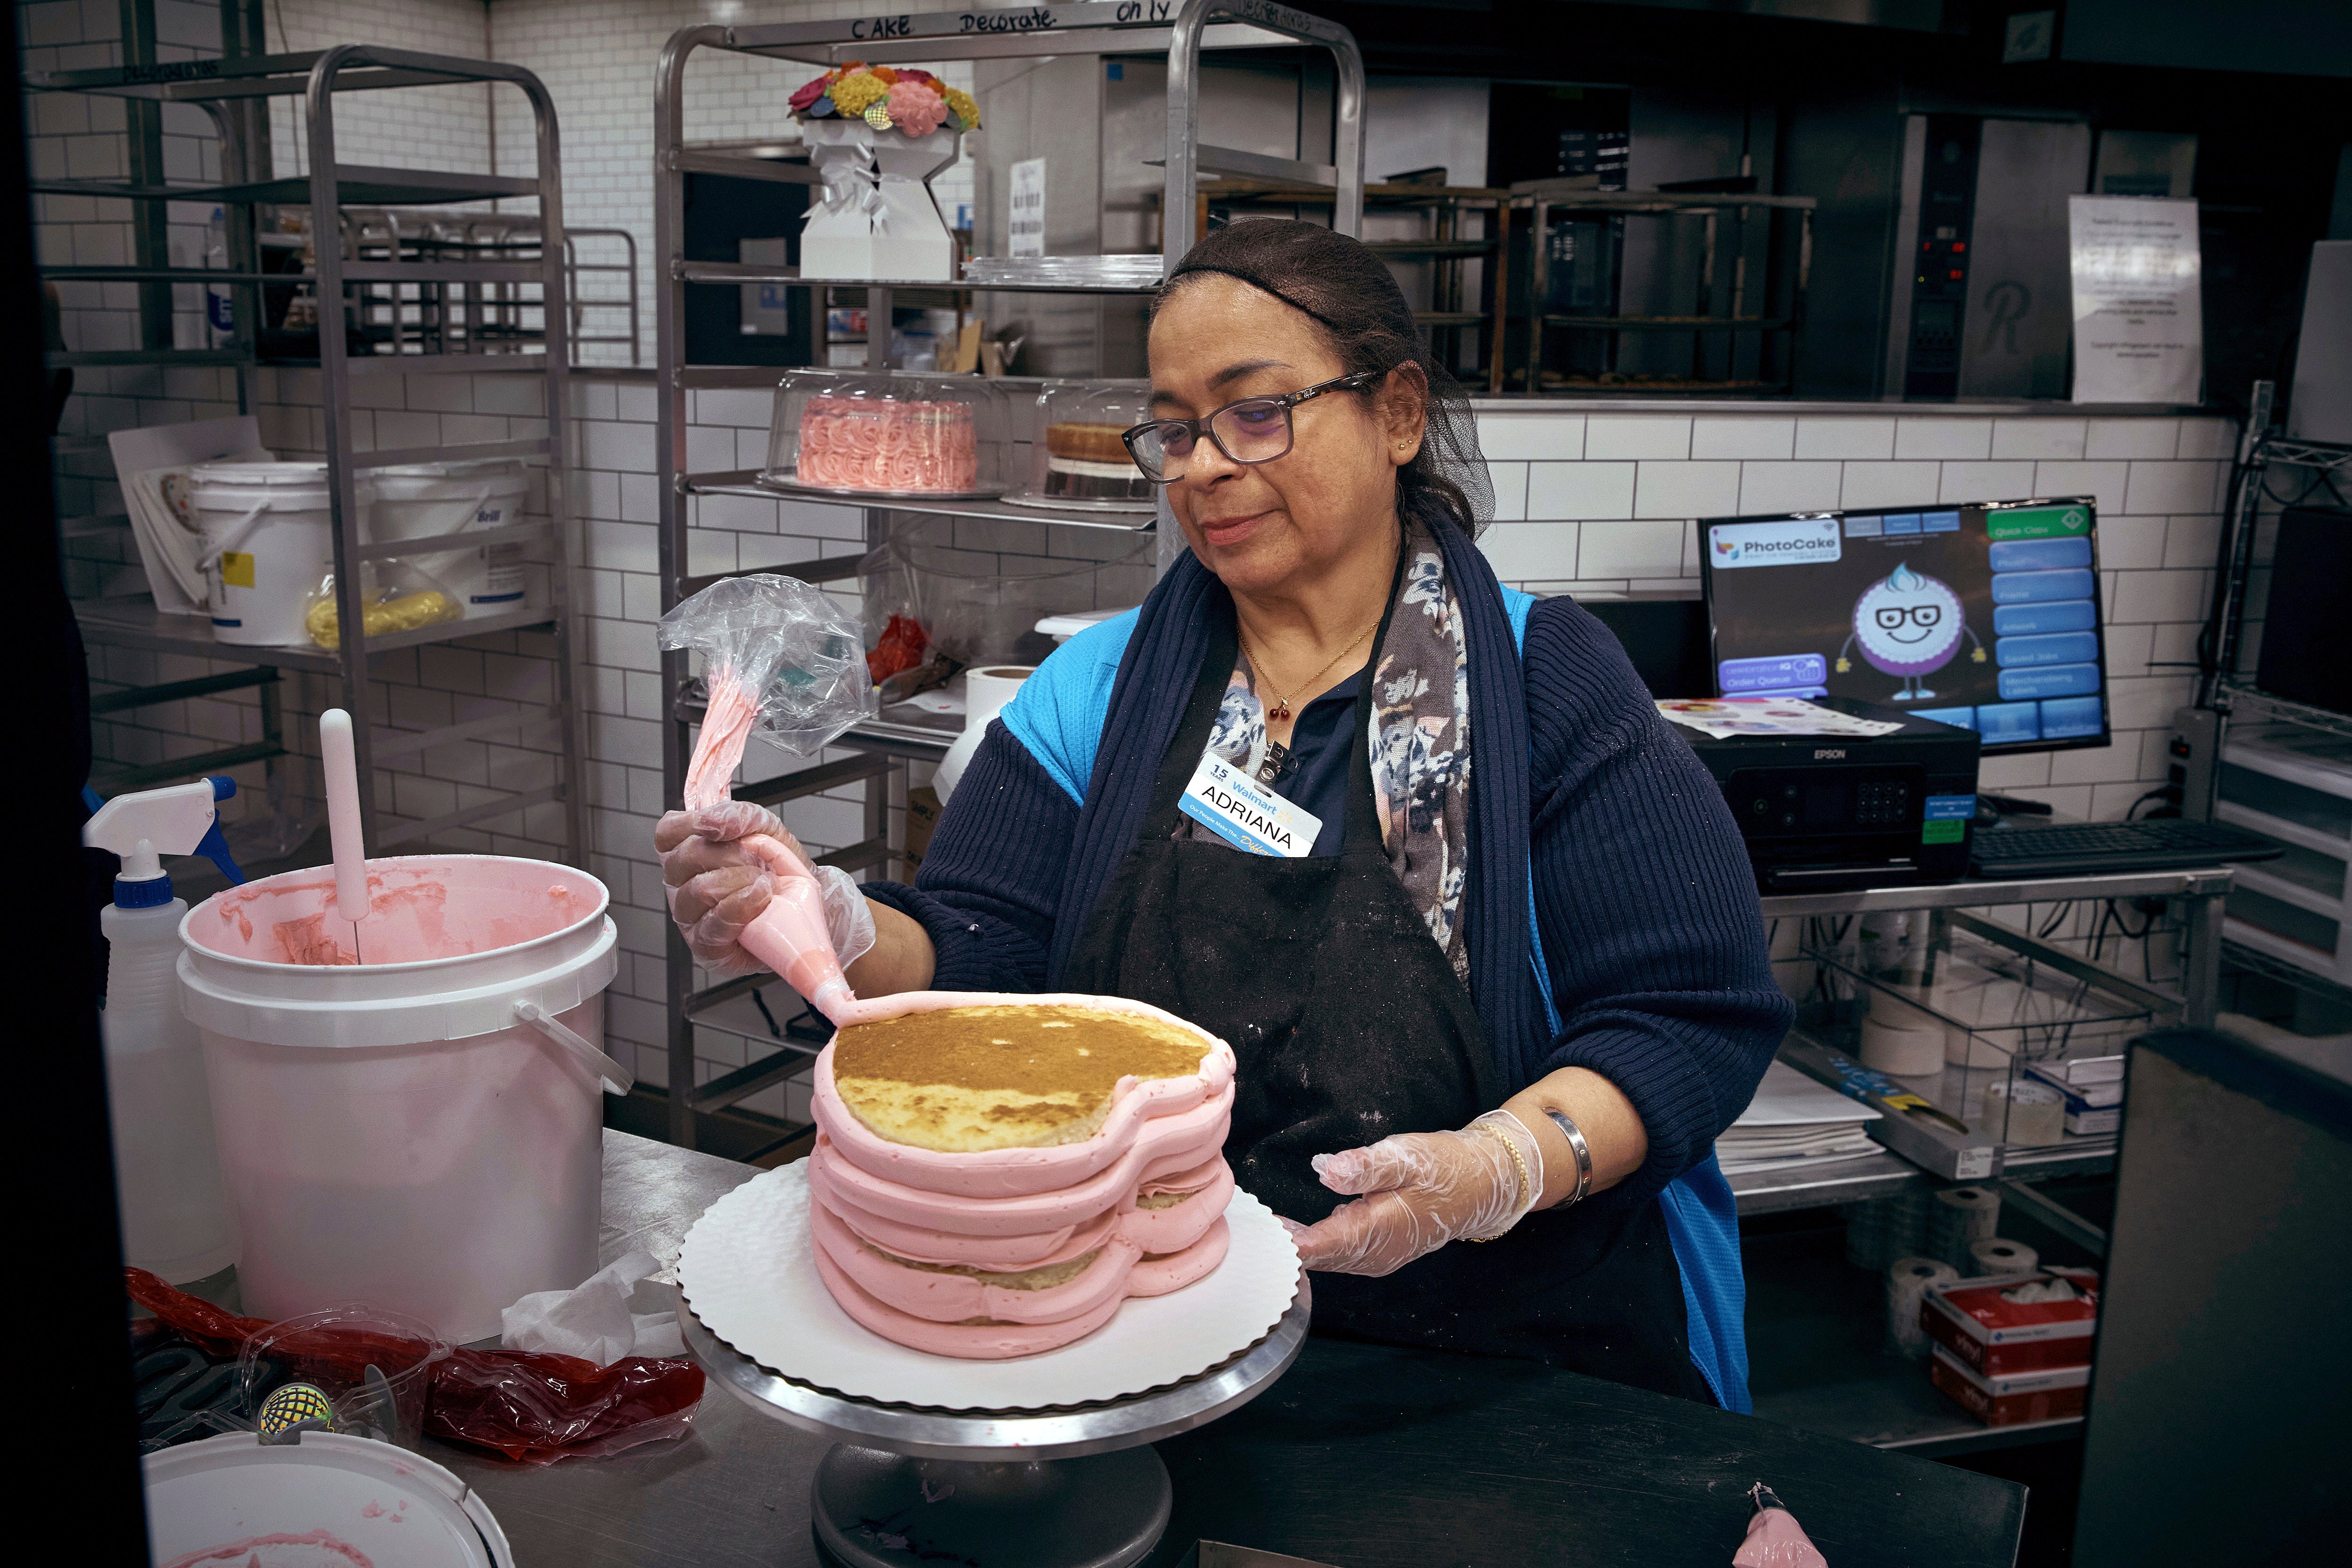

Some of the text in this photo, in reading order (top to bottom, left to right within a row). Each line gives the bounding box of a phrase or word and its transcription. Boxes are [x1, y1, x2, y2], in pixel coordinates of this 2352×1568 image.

[852, 15, 911, 39] CAKE
[1744, 537, 1836, 553] PhotoCake
[1814, 749, 1846, 759] EPSON
[1210, 771, 1224, 782] YEARS
[1214, 764, 1229, 779] 15
[1233, 781, 1277, 815] Walmart
[1190, 804, 1199, 813] Our
[1199, 810, 1216, 823] People
[1215, 821, 1228, 832] Make
[1201, 786, 1291, 850] ADRIANA
